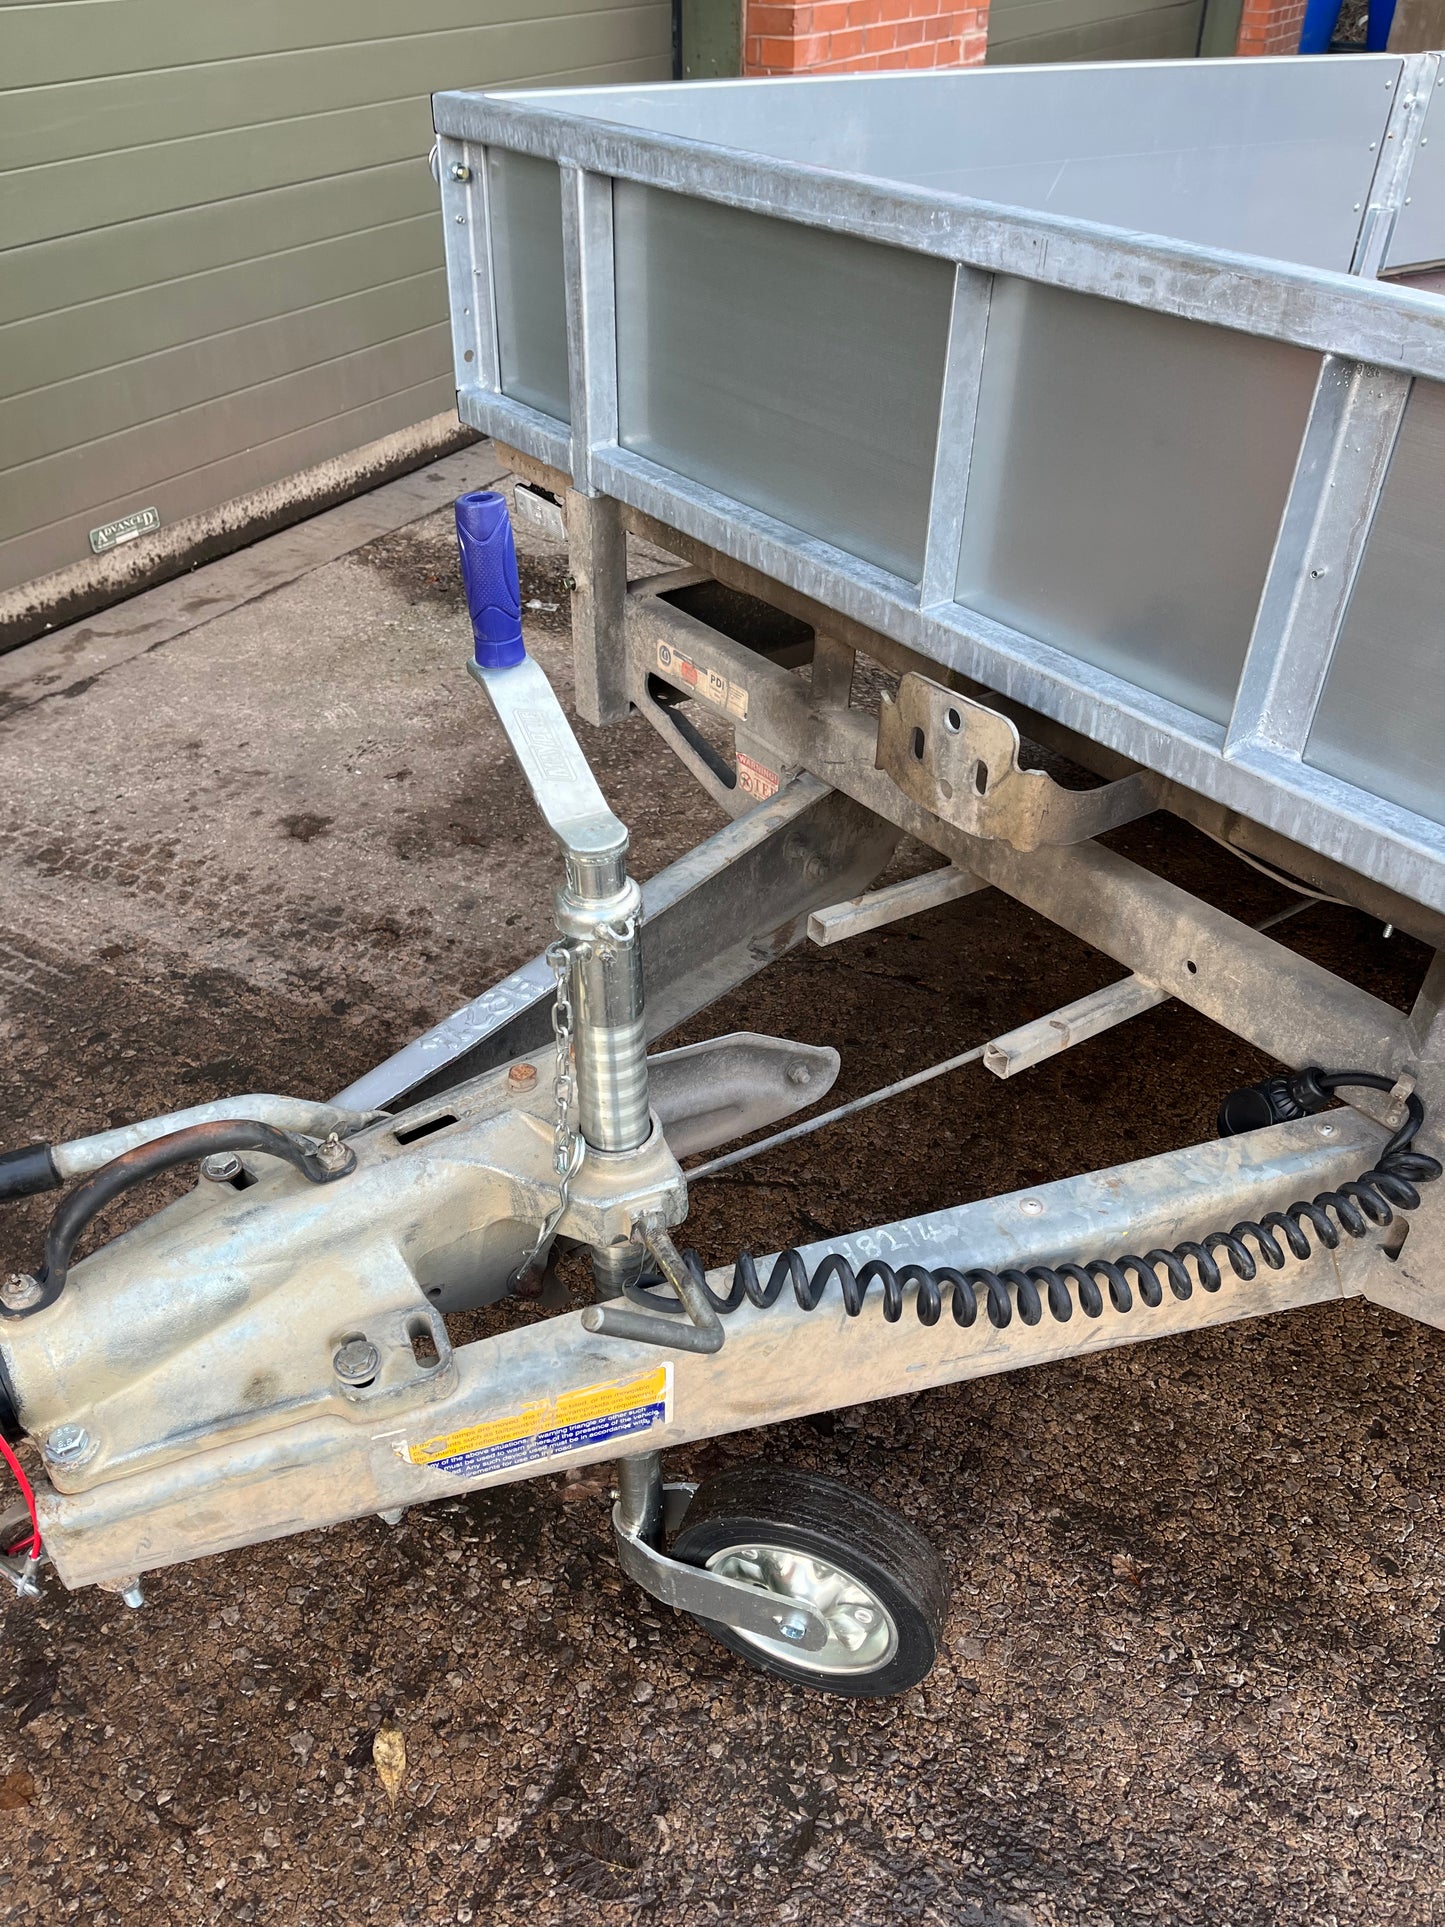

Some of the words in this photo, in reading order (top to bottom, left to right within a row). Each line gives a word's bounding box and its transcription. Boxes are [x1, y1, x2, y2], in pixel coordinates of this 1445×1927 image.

[97, 511, 154, 545] ADVANCED
[710, 674, 725, 690] PDI
[443, 1461, 463, 1470] must
[464, 1458, 475, 1466] be
[476, 1452, 496, 1462] used
[506, 1445, 525, 1454] warn
[561, 1431, 574, 1439] the
[575, 1422, 609, 1437] presence
[619, 1416, 632, 1424] the
[450, 1455, 463, 1463] the
[465, 1448, 489, 1459] above
[538, 1428, 568, 1440] warning
[569, 1419, 597, 1431] triangle
[607, 1412, 627, 1421] other
[628, 1407, 646, 1416] such
[466, 1463, 481, 1472] Any
[482, 1457, 501, 1467] such
[502, 1450, 527, 1461] device
[528, 1444, 548, 1454] used
[549, 1438, 568, 1448] must
[514, 1456, 529, 1464] use
